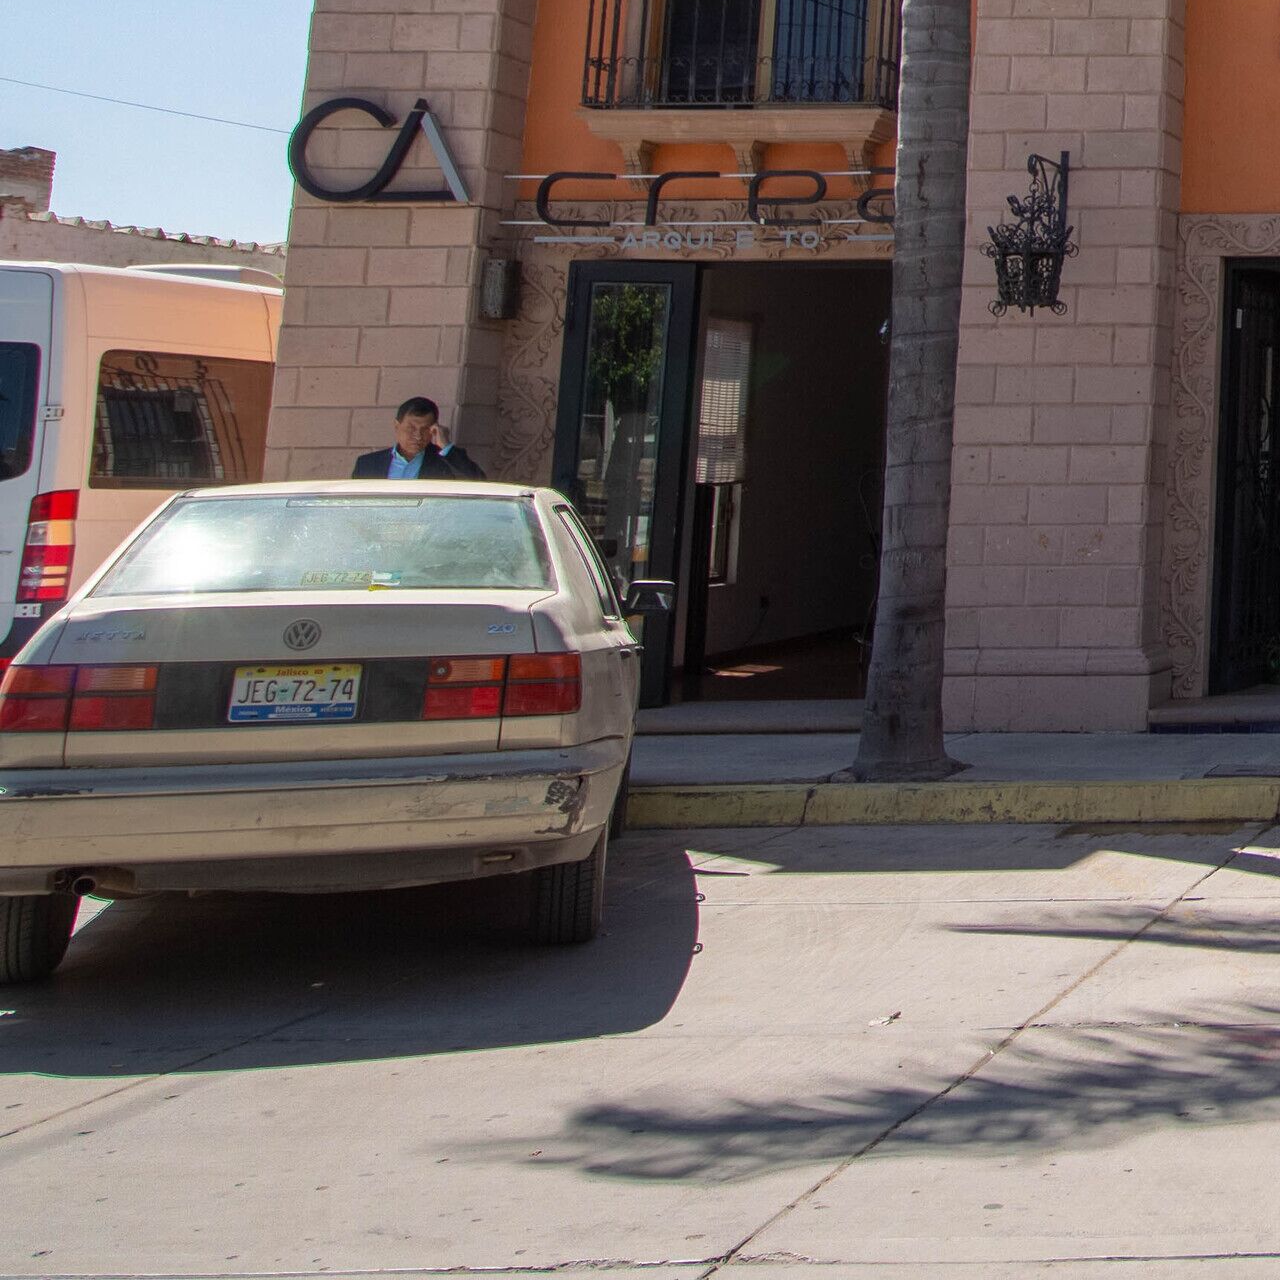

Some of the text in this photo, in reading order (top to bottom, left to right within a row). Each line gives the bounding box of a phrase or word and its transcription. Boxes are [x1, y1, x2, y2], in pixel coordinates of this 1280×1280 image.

[276, 668, 309, 676] Jalisco
[237, 678, 355, 704] JEG-72-74
[275, 705, 312, 713] México
